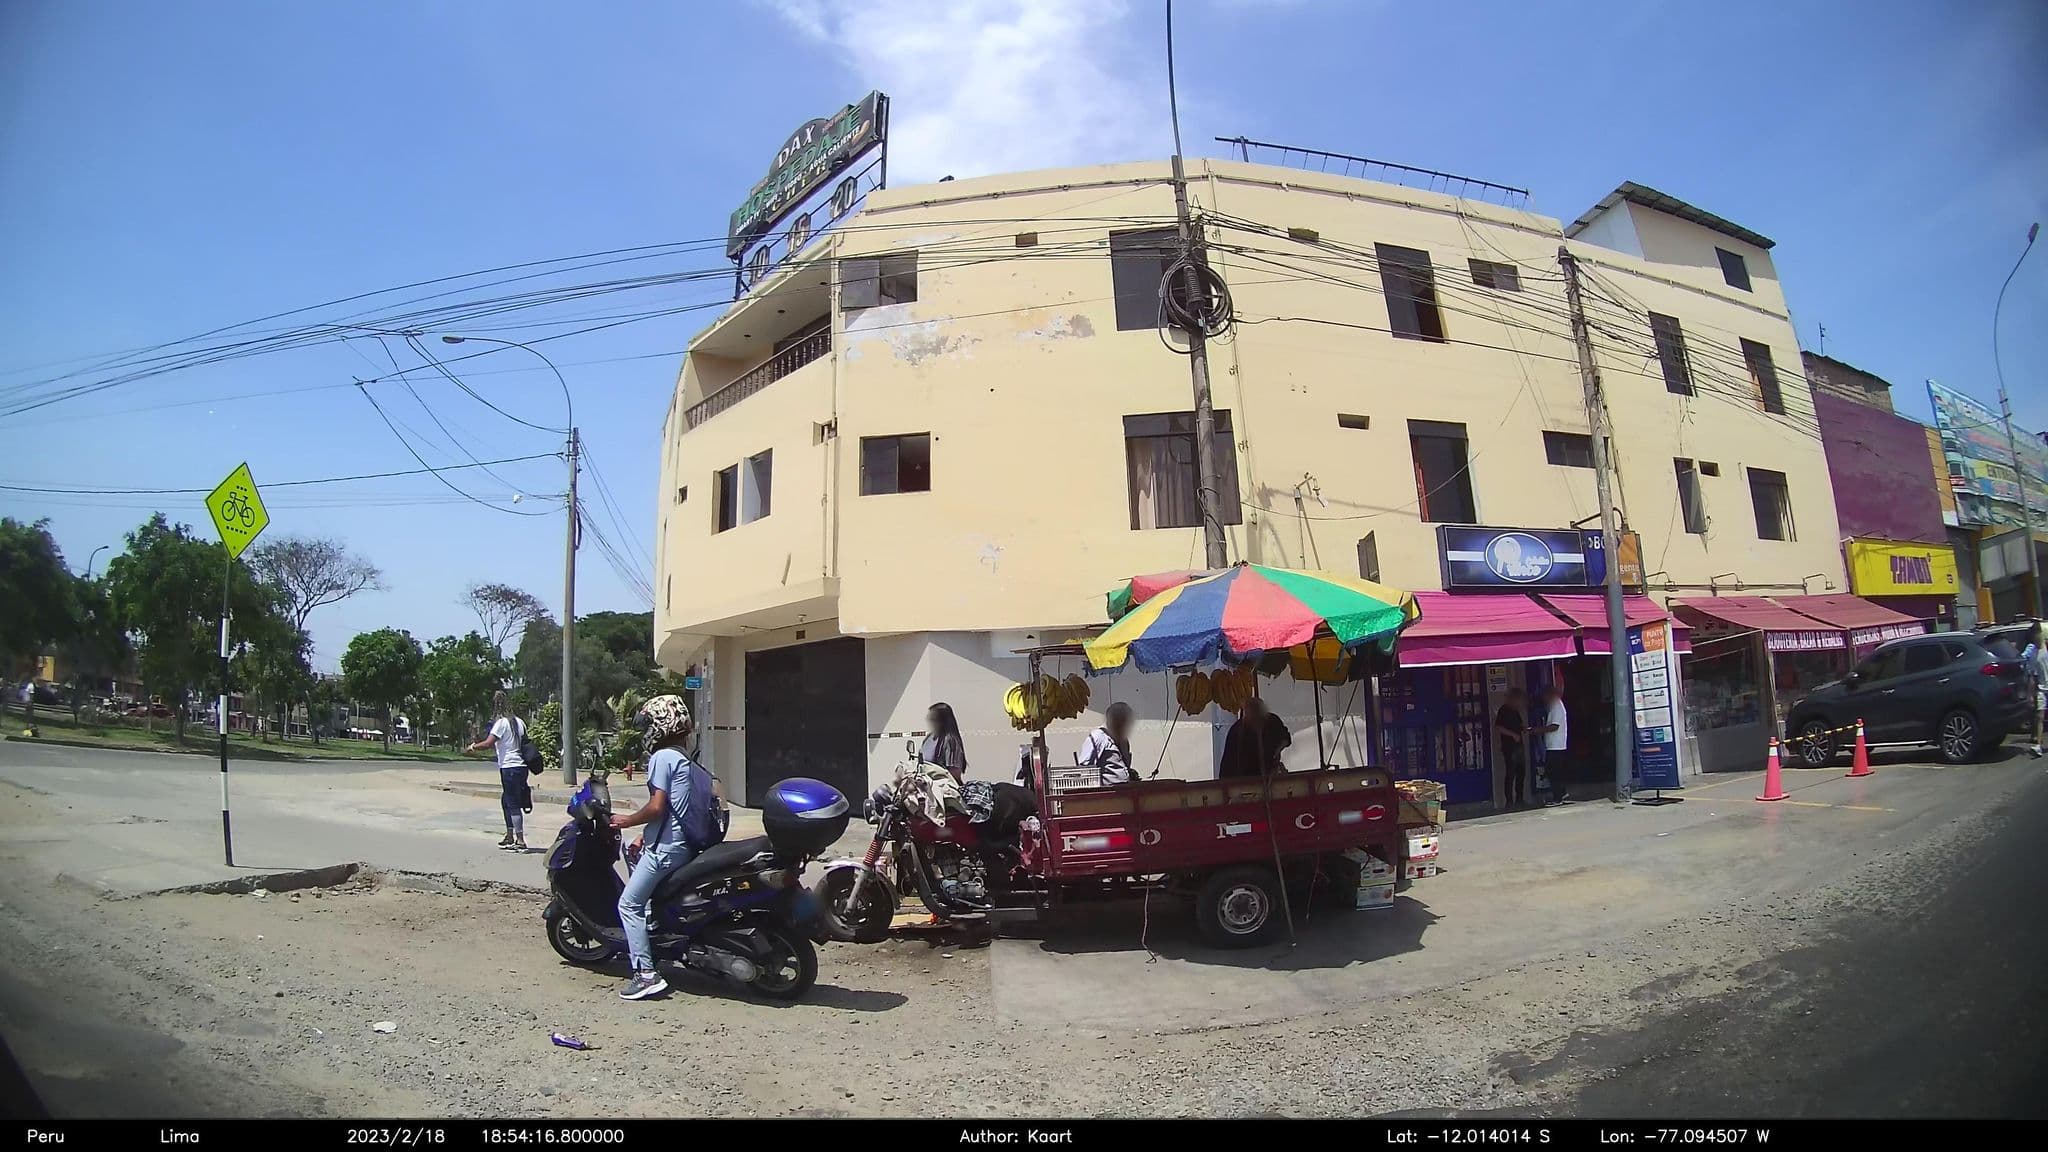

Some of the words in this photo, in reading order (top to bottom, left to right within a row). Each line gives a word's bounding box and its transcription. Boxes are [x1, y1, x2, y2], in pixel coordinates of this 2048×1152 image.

[738, 105, 861, 222] HOSPEDAJE
[777, 124, 816, 168] DAX
[808, 153, 827, 174] AGUA
[828, 125, 861, 155] CALIENTE
[834, 179, 854, 218] 20
[789, 216, 808, 253] 15
[1890, 555, 1933, 585] TAMBO
